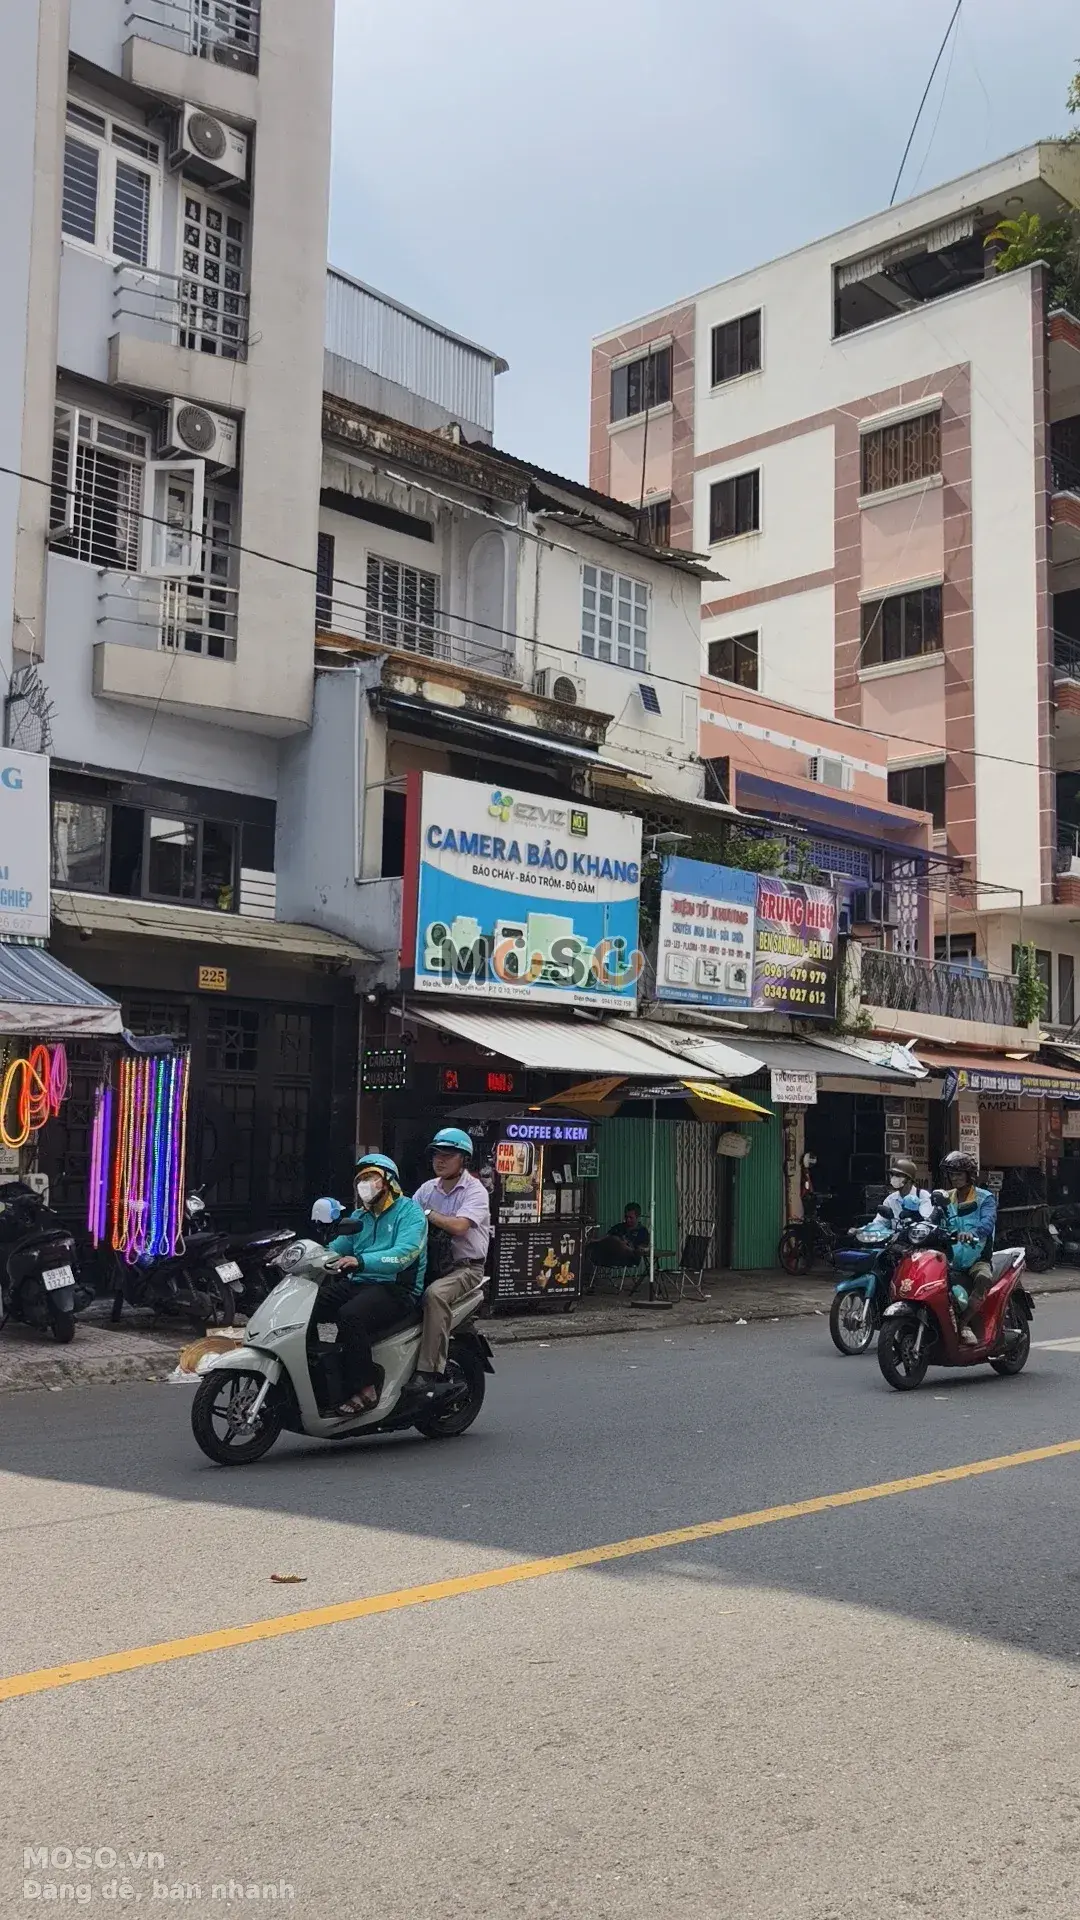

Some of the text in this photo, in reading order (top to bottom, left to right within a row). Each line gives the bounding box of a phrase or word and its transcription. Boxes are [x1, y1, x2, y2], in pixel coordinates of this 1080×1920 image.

[514, 802, 566, 826] EZVIZ
[426, 824, 639, 885] CAMERA BẢO KHANG
[472, 864, 489, 877] BÁO
[491, 867, 514, 882] CHÁY
[519, 872, 536, 885] BÁO
[538, 875, 562, 890] TRỘM
[565, 880, 577, 894] BỘ
[577, 880, 595, 895] ĐÀM
[760, 891, 804, 926] TRUNG
[202, 970, 225, 983] 225
[764, 963, 827, 985] 0961 479 979
[764, 984, 826, 1004] 0342 027 612
[979, 1101, 1016, 1111] AMPLI
[507, 1124, 588, 1140] COFFEE & KEM
[499, 1144, 514, 1157] PHA
